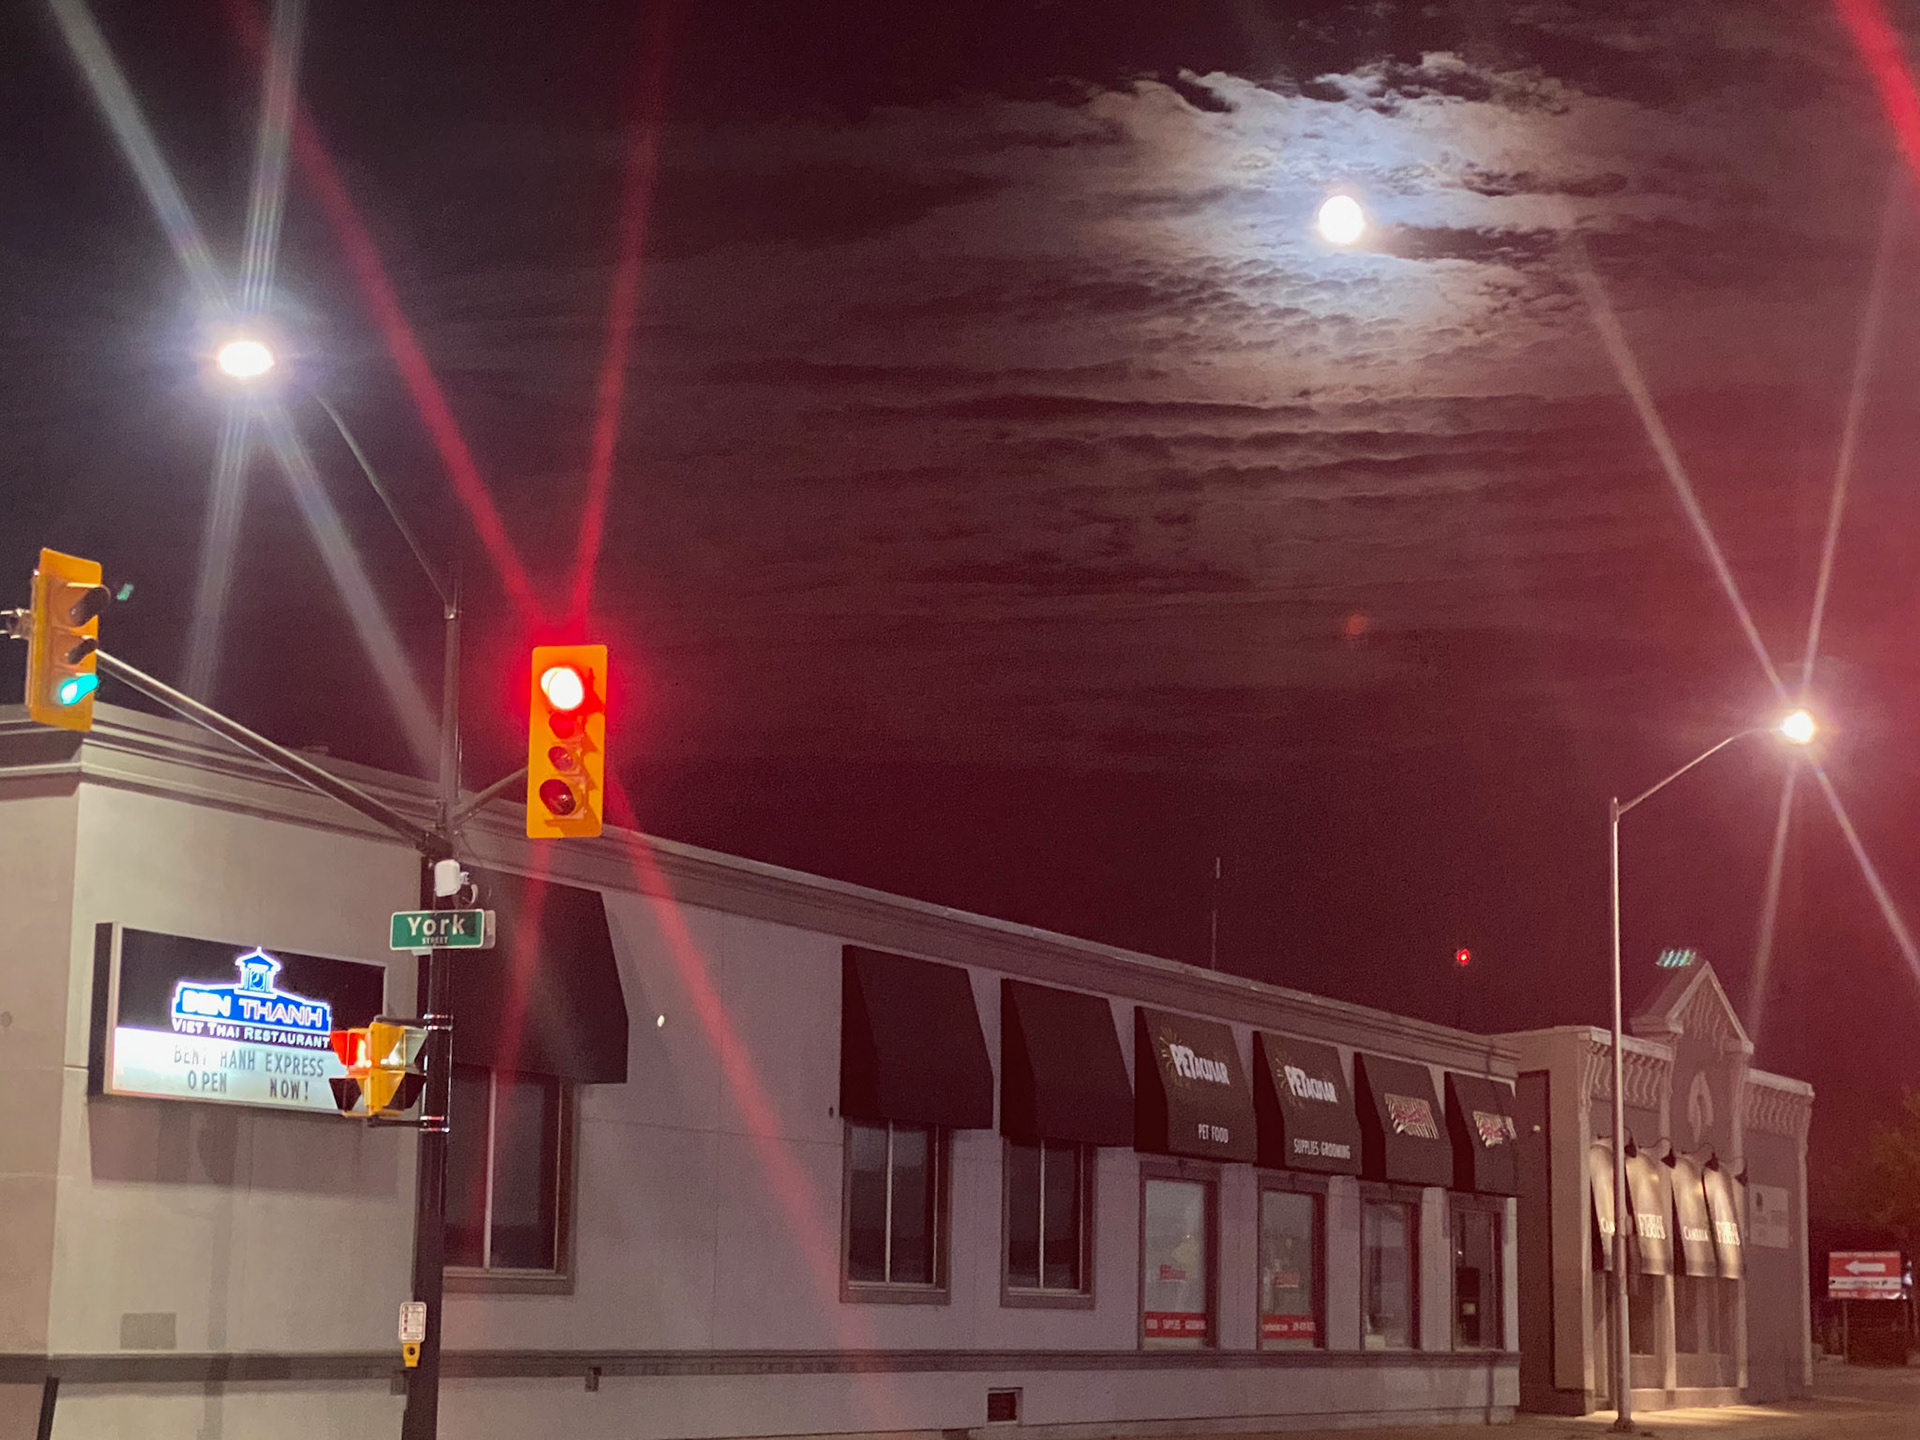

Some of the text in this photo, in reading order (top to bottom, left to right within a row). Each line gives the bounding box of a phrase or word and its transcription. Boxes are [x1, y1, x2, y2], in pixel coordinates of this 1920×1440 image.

[407, 914, 465, 936] York
[422, 937, 448, 945] STREET
[182, 989, 323, 1028] BEN THANH
[172, 1018, 330, 1048] VIET THAI RESTAURANT
[265, 1053, 324, 1077] EXPRESS
[188, 1070, 309, 1100] OPEN NOW!
[1198, 1123, 1229, 1143] PET FOOD
[1293, 1138, 1319, 1155] SUPPLIES
